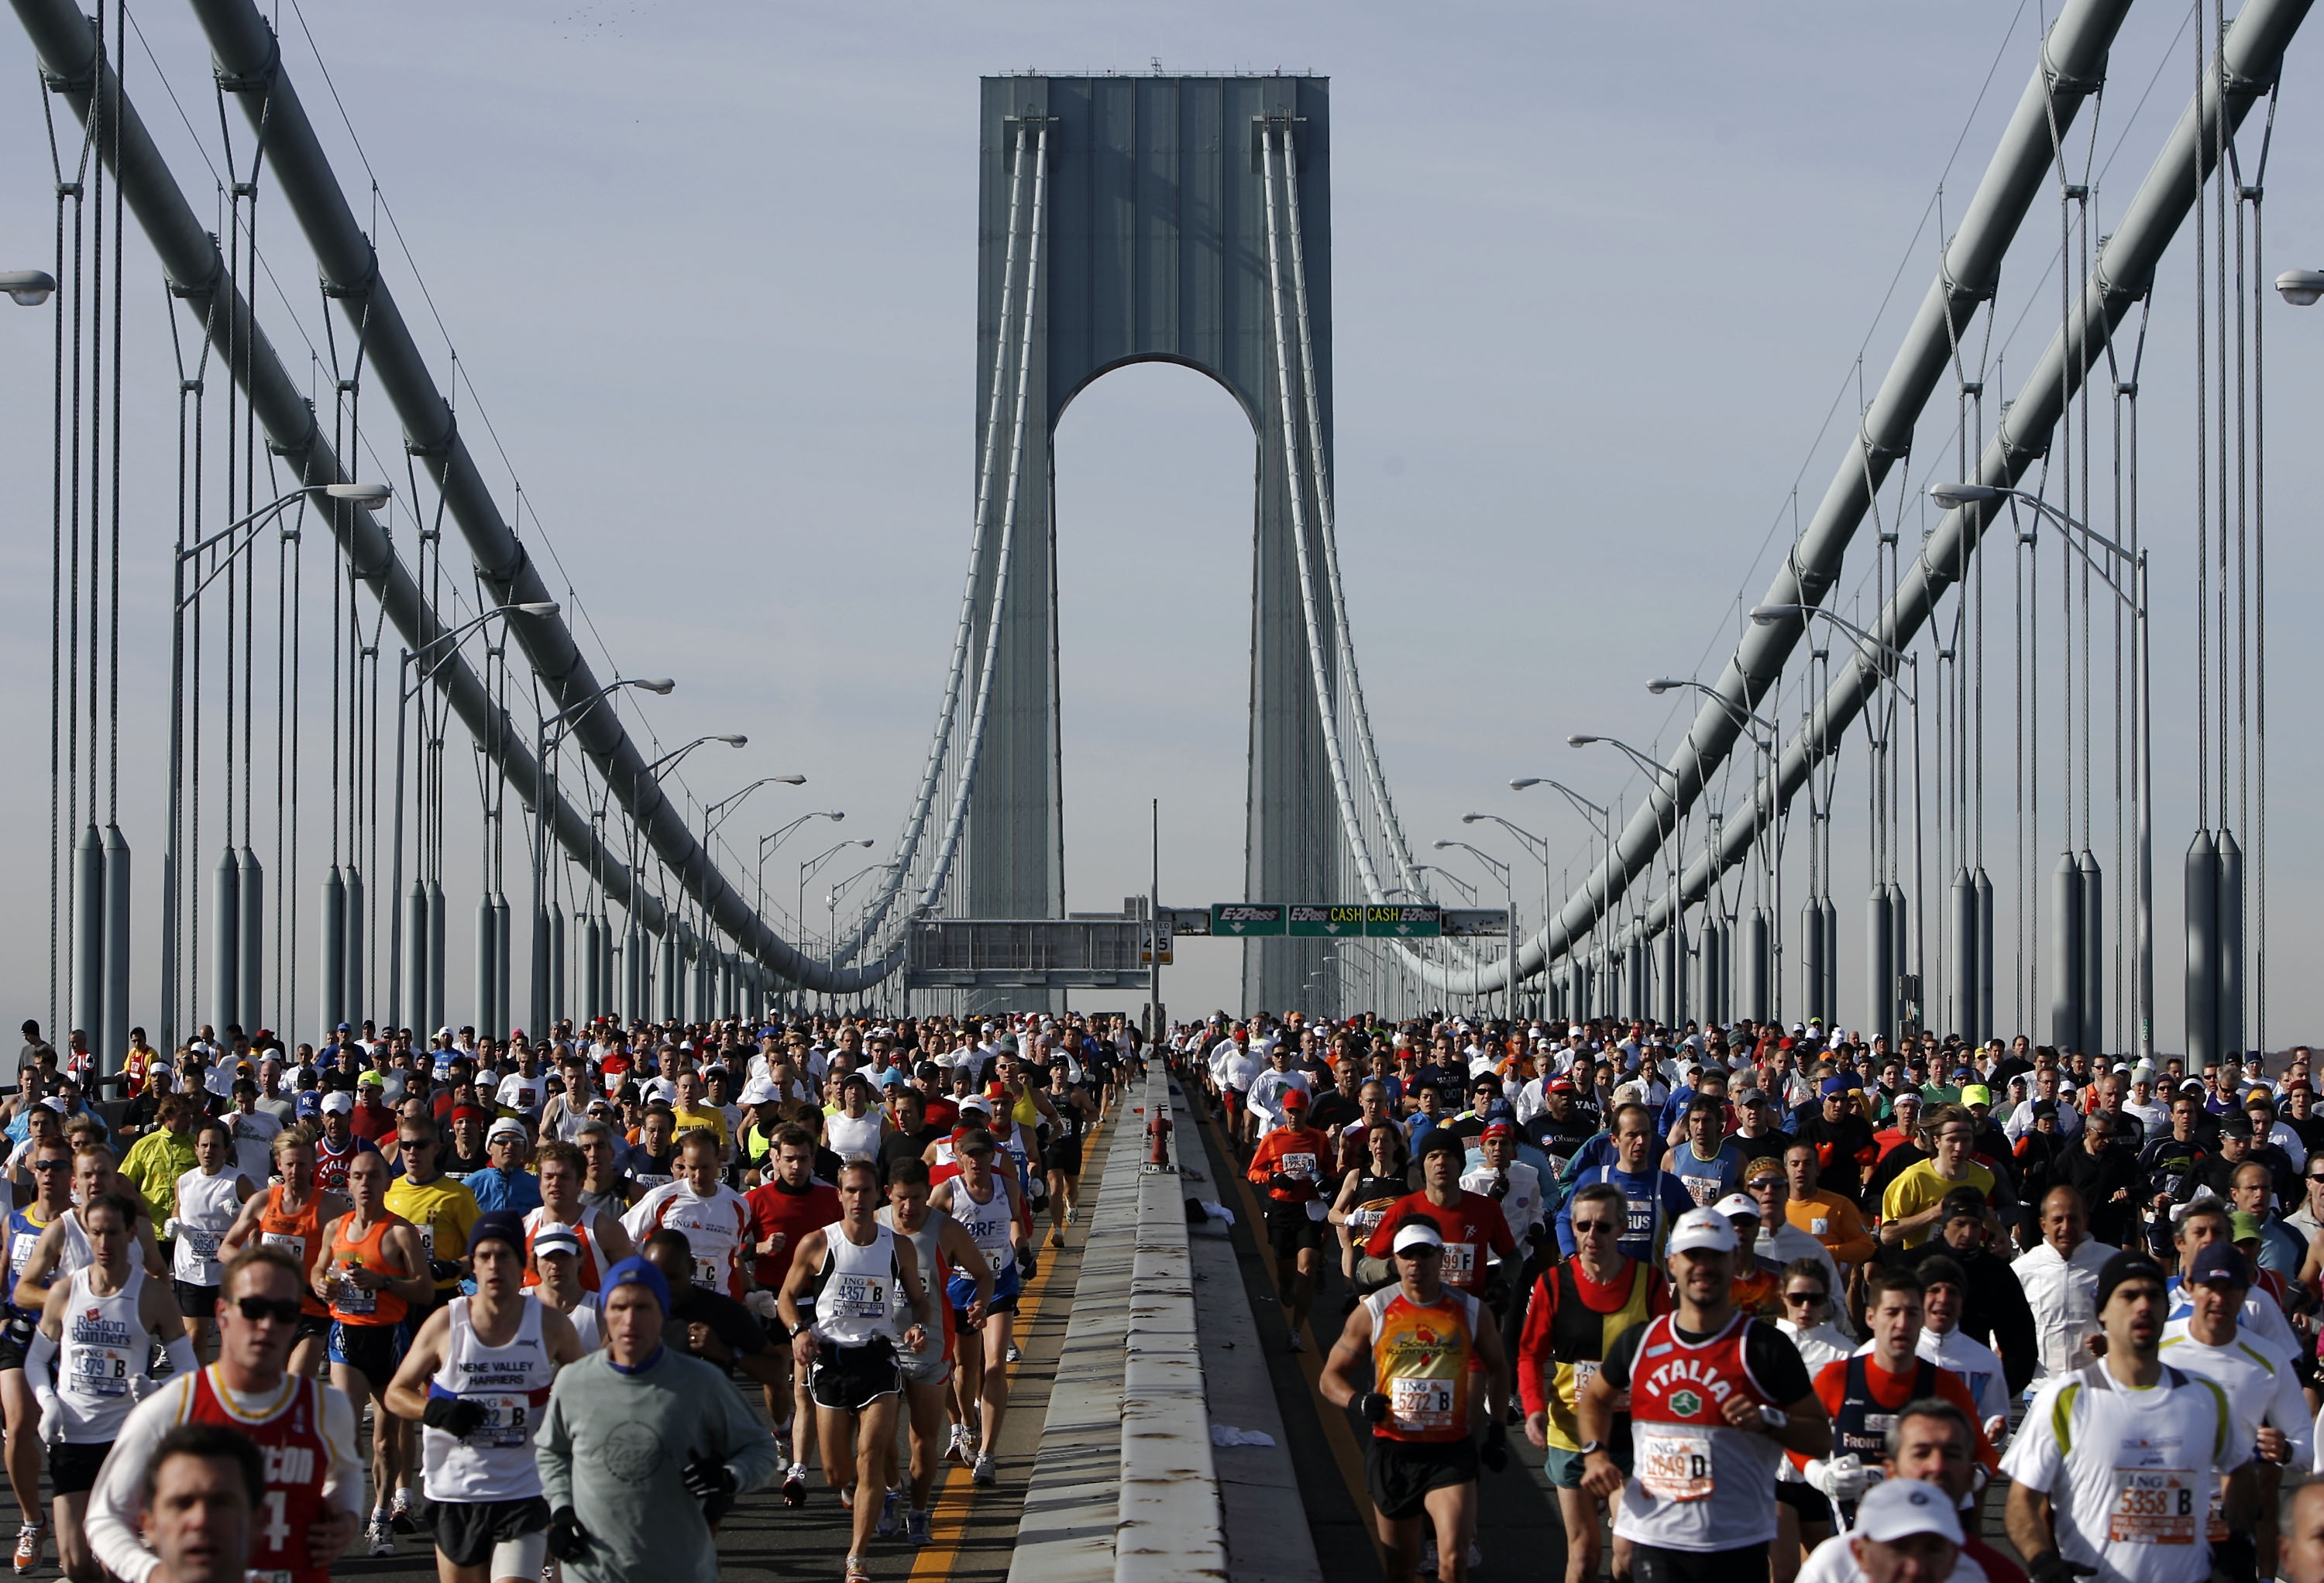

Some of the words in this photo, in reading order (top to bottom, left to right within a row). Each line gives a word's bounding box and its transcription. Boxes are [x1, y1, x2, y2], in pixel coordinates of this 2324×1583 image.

[1331, 907, 1362, 922] CASH
[1367, 907, 1398, 922] CASH
[1143, 937, 1168, 951] 45
[302, 1097, 314, 1107] NY
[1553, 1134, 1580, 1143] Obama
[1709, 1187, 1717, 1200] B
[672, 1219, 690, 1228] ING
[194, 1239, 215, 1251] 8050
[422, 1234, 431, 1248] C
[992, 1256, 1000, 1270] C
[1463, 1253, 1471, 1270] F
[706, 1265, 716, 1280] C
[844, 1277, 865, 1286] ING
[838, 1285, 866, 1301] 4357
[873, 1286, 883, 1302] B
[76, 1315, 126, 1334] Reston
[71, 1327, 131, 1346] Runners
[114, 1358, 126, 1378] B
[459, 1362, 490, 1372] NENE
[491, 1362, 535, 1372] VALLEY
[468, 1375, 524, 1386] HARRIERS
[1401, 1382, 1427, 1392] ING
[1645, 1358, 1732, 1403] ITALIA
[1398, 1392, 1432, 1410] 5272
[1439, 1392, 1449, 1411] B
[512, 1406, 525, 1427] B
[1842, 1432, 1882, 1449] FRONT
[1650, 1442, 1675, 1454] ING
[1692, 1454, 1705, 1477] D
[2128, 1475, 2164, 1489] ING
[2120, 1489, 2168, 1515] 5358
[2178, 1489, 2192, 1516] B
